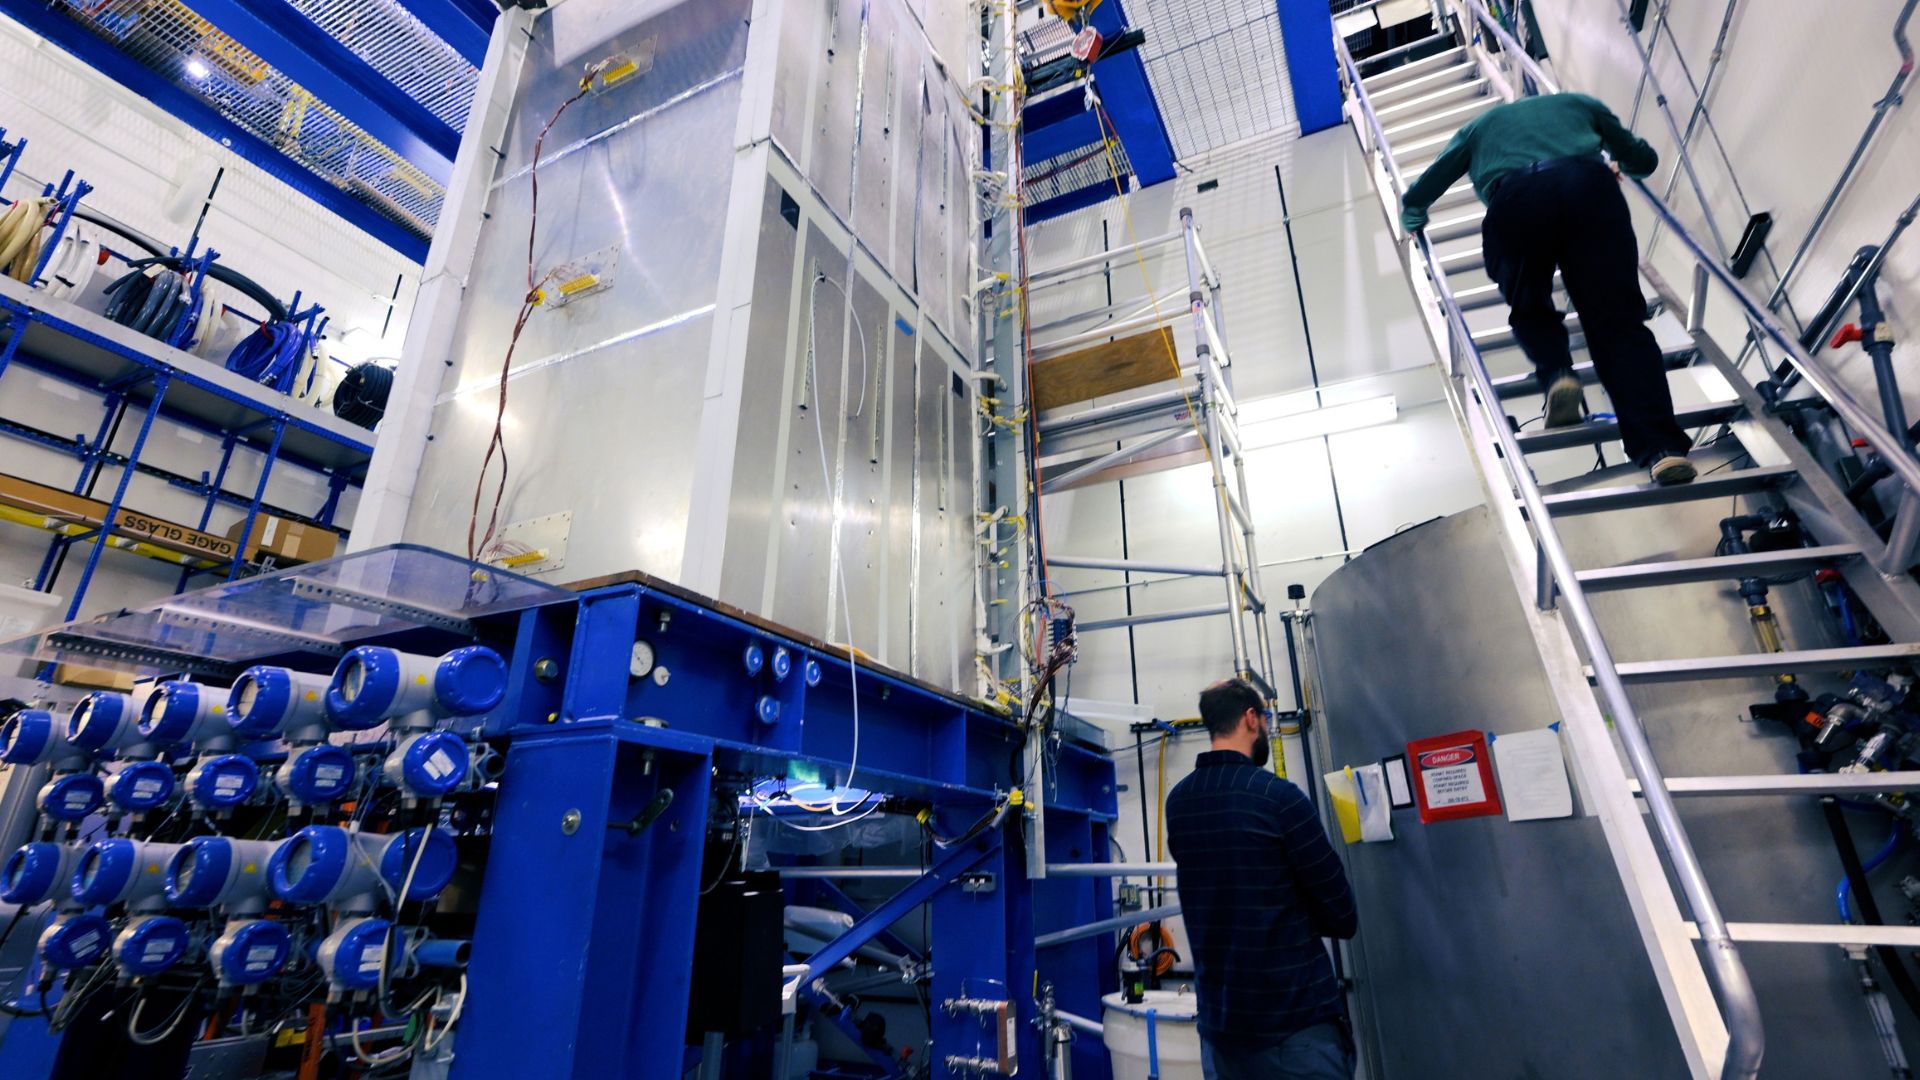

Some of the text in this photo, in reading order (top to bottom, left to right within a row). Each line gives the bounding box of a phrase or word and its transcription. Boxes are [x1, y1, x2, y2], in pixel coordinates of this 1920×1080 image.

[124, 515, 231, 554] GAGE GLASS
[1432, 752, 1460, 764] DANGER
